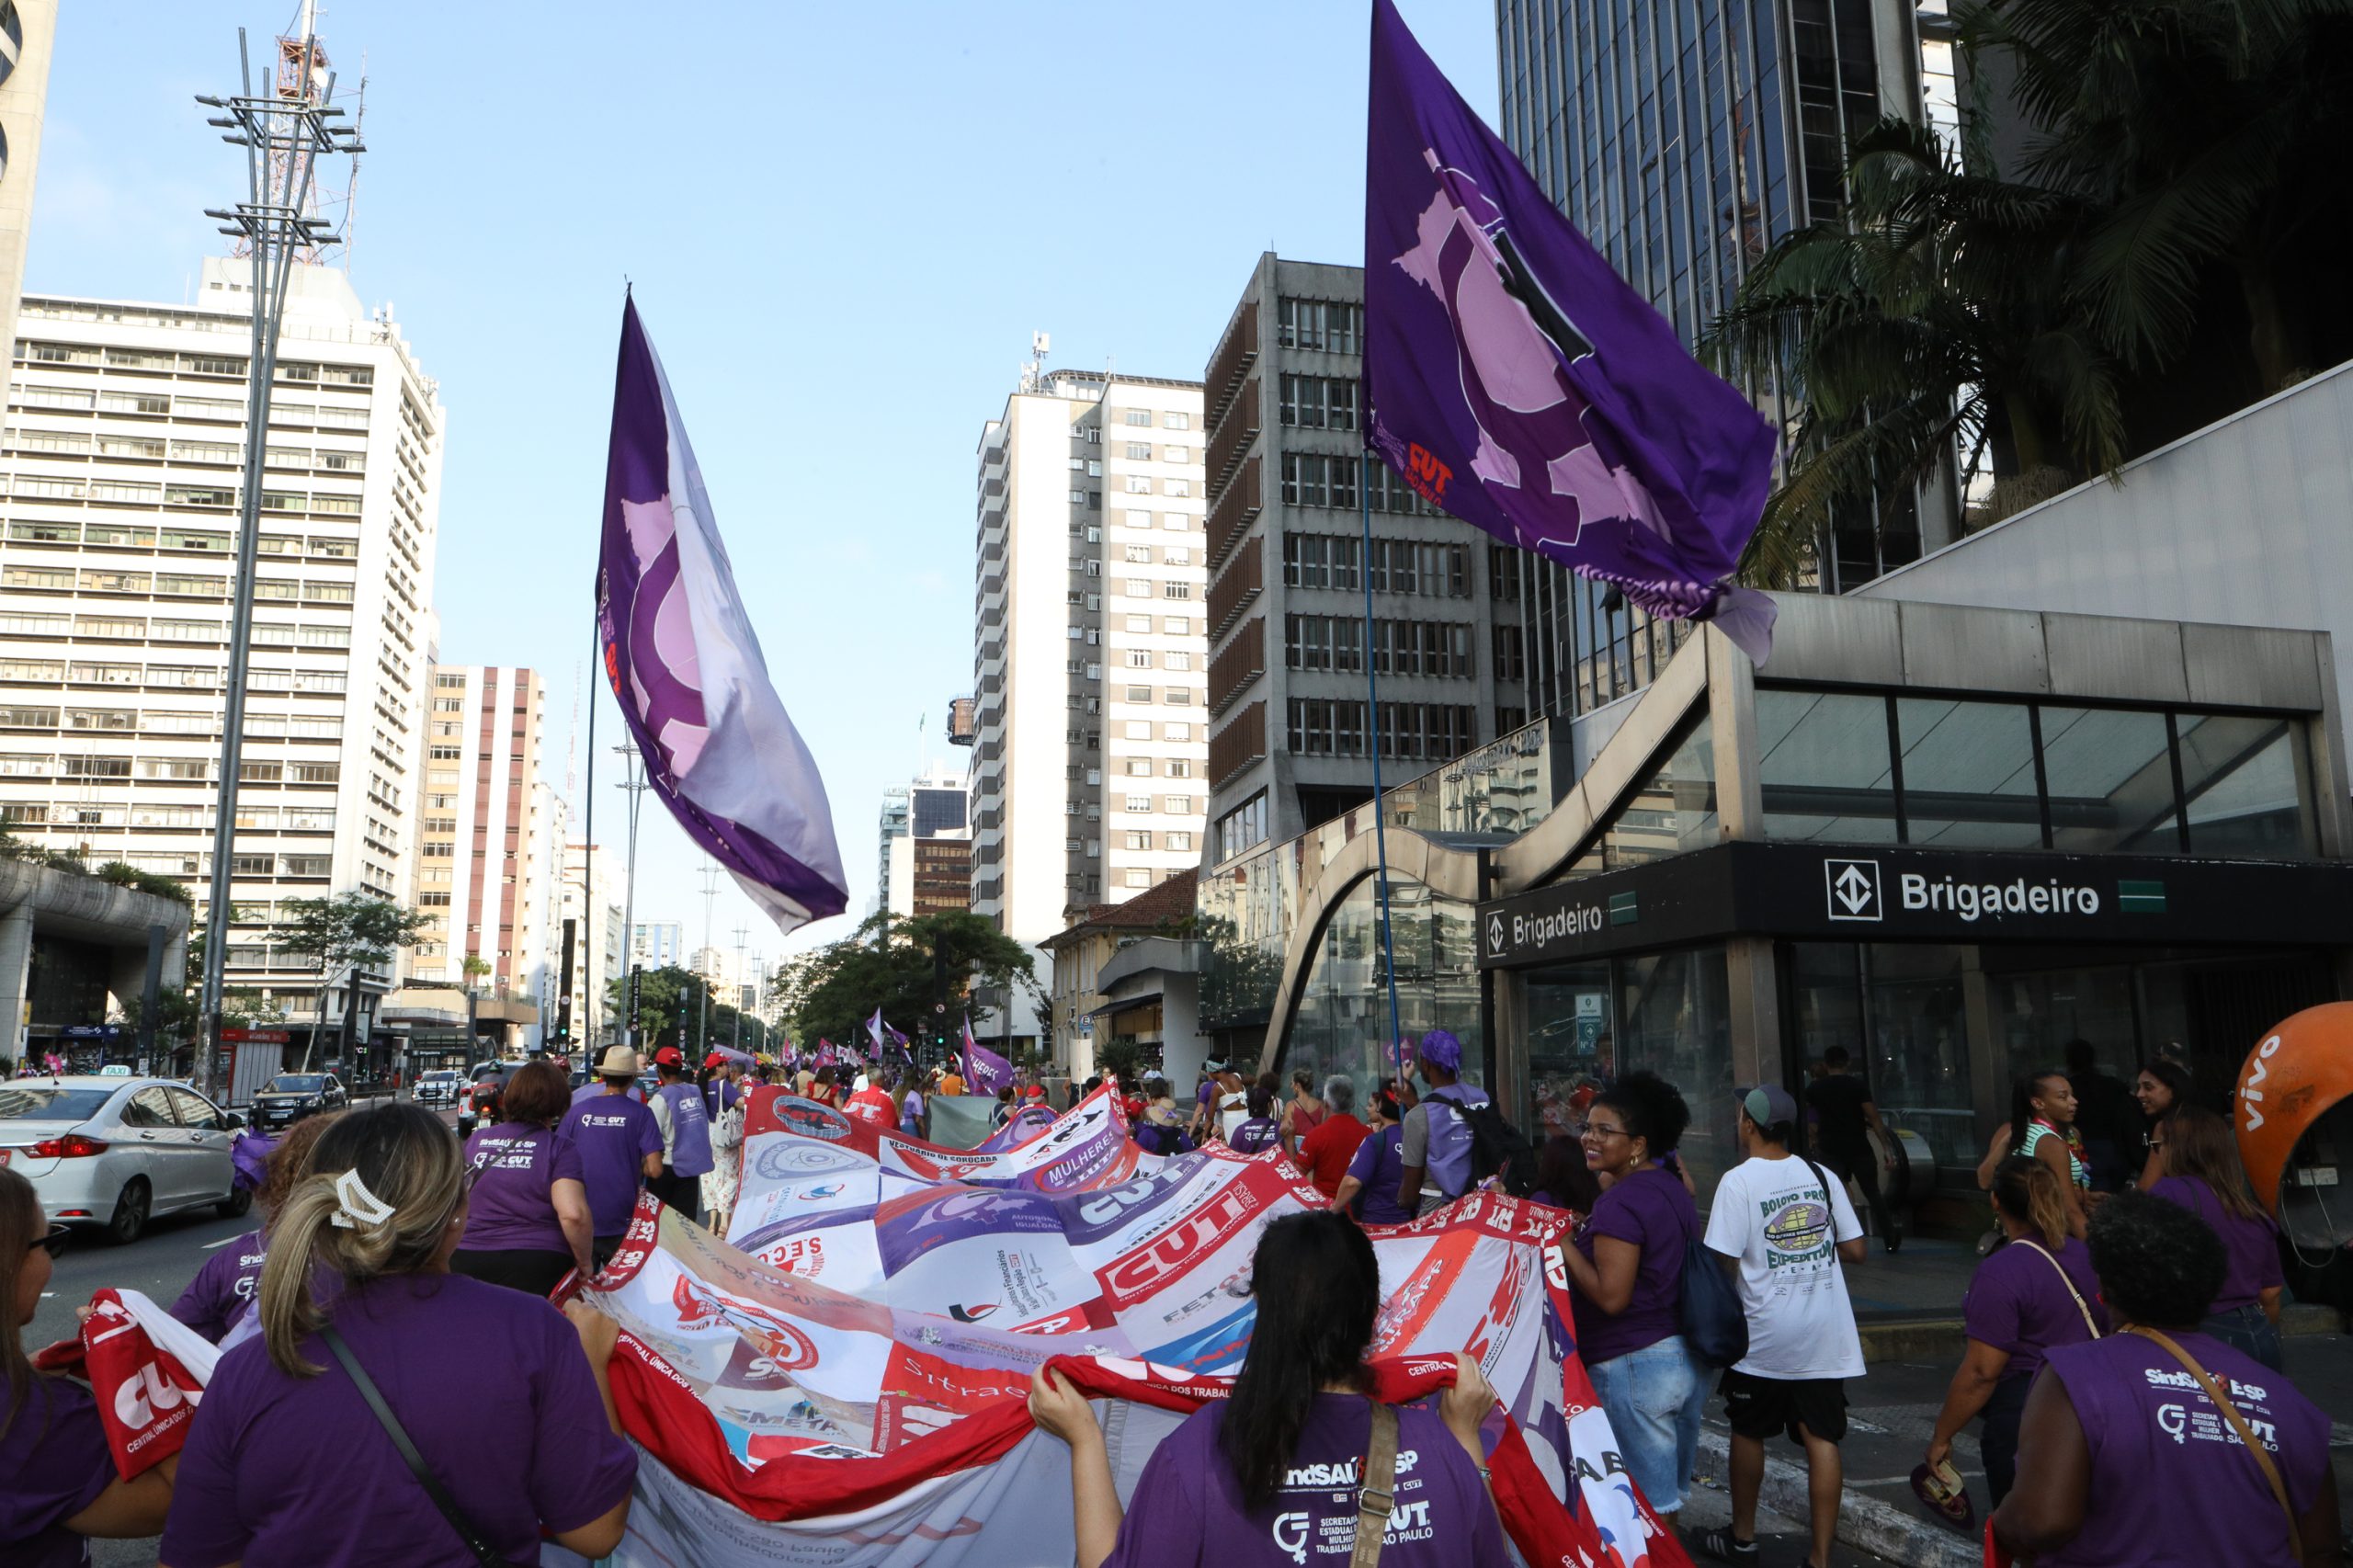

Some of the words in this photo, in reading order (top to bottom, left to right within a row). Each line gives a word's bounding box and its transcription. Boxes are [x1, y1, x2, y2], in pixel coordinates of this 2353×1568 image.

[1409, 441, 1453, 494] CUT
[1901, 873, 2099, 921] Brigadeiro
[1514, 902, 1602, 949] Brigadeiro
[106, 1066, 127, 1075] TAXI
[970, 1053, 999, 1081] LHERES
[2241, 1035, 2280, 1132] vivo
[841, 1101, 882, 1119] UT
[507, 1155, 533, 1165] CUT
[1049, 1131, 1114, 1184] MULHERES
[1080, 1163, 1184, 1225] CUT
[1485, 1205, 1515, 1233] CUT
[1114, 1193, 1234, 1290] CUT
[1119, 1284, 1156, 1302] CENTRAL
[618, 1335, 649, 1362] CENTRAL
[649, 1356, 674, 1378] ÚNICA
[671, 1374, 688, 1389] DOS
[1408, 1362, 1447, 1376] CENTRAL
[1171, 1385, 1191, 1396] DOS
[1192, 1386, 1233, 1398] TRABAL
[127, 1431, 156, 1453] CENTRAL
[155, 1422, 175, 1437] ÚNICA
[174, 1412, 188, 1425] DOS
[1404, 1480, 1423, 1491] CUT
[1319, 1526, 1354, 1537] ESTADUAL
[1398, 1527, 1434, 1544] PAULO
